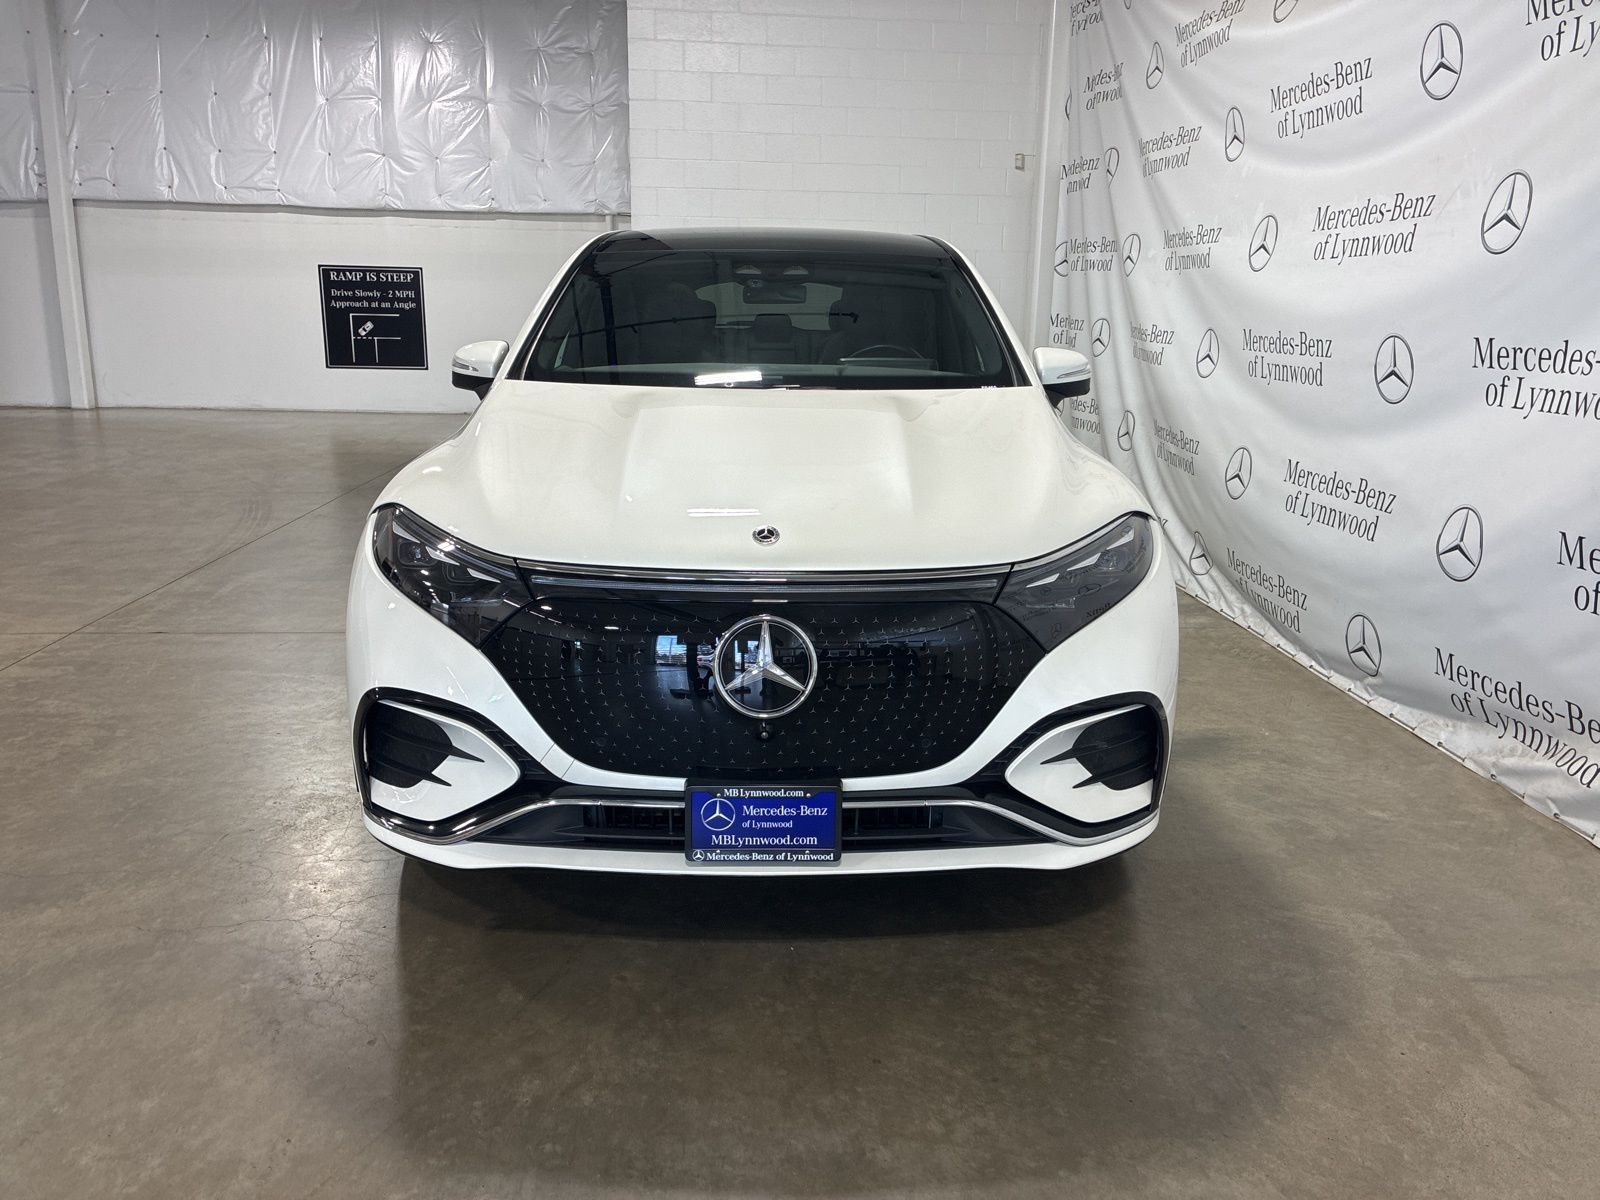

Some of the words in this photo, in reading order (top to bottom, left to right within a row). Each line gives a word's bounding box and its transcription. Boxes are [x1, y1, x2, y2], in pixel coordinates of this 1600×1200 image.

[1181, 43, 1188, 68] of
[1189, 18, 1234, 67] Lynnwood
[1541, 20, 1567, 61] of
[1569, 15, 1600, 58] Ly
[1270, 57, 1373, 113] Mercedes-Benz
[1277, 111, 1289, 139] of
[1291, 86, 1364, 139] Lynnwood
[1312, 192, 1436, 232] Mercedes-Benz
[1162, 224, 1222, 249] Mercedes-Benz
[1313, 234, 1331, 261] of
[1330, 223, 1418, 266] Lynnwood
[330, 271, 363, 281] RAMP
[366, 272, 377, 282] IS
[380, 272, 414, 283] STEEP
[1165, 251, 1174, 271] of
[1174, 247, 1211, 275] Lynnwood
[330, 300, 369, 309] Approach
[393, 301, 417, 310] Angle
[331, 289, 353, 297] Drive
[355, 289, 381, 298] Slowly
[388, 290, 393, 298] 2
[395, 290, 415, 298] MPH
[1242, 328, 1333, 359] Mercedes-Benz
[1248, 355, 1259, 378] of
[1260, 356, 1324, 386] Lynnwood
[1485, 374, 1511, 408] of
[1283, 458, 1397, 515] Mercedes-Benz
[1285, 491, 1302, 514] of
[1300, 492, 1380, 542] Lynnwood
[1556, 530, 1600, 575] Me
[1226, 547, 1308, 612] Mercedes-Benz
[1574, 580, 1600, 616] of
[1451, 691, 1477, 718] of
[742, 805, 828, 816] Mercedes-Benz
[742, 820, 751, 828] of
[752, 820, 793, 830] Lynnwood
[711, 834, 818, 847] MBLynnwood.com
[706, 852, 774, 861] Mercedes-Benz
[776, 852, 785, 861] of
[787, 852, 834, 862] Lynnwood
